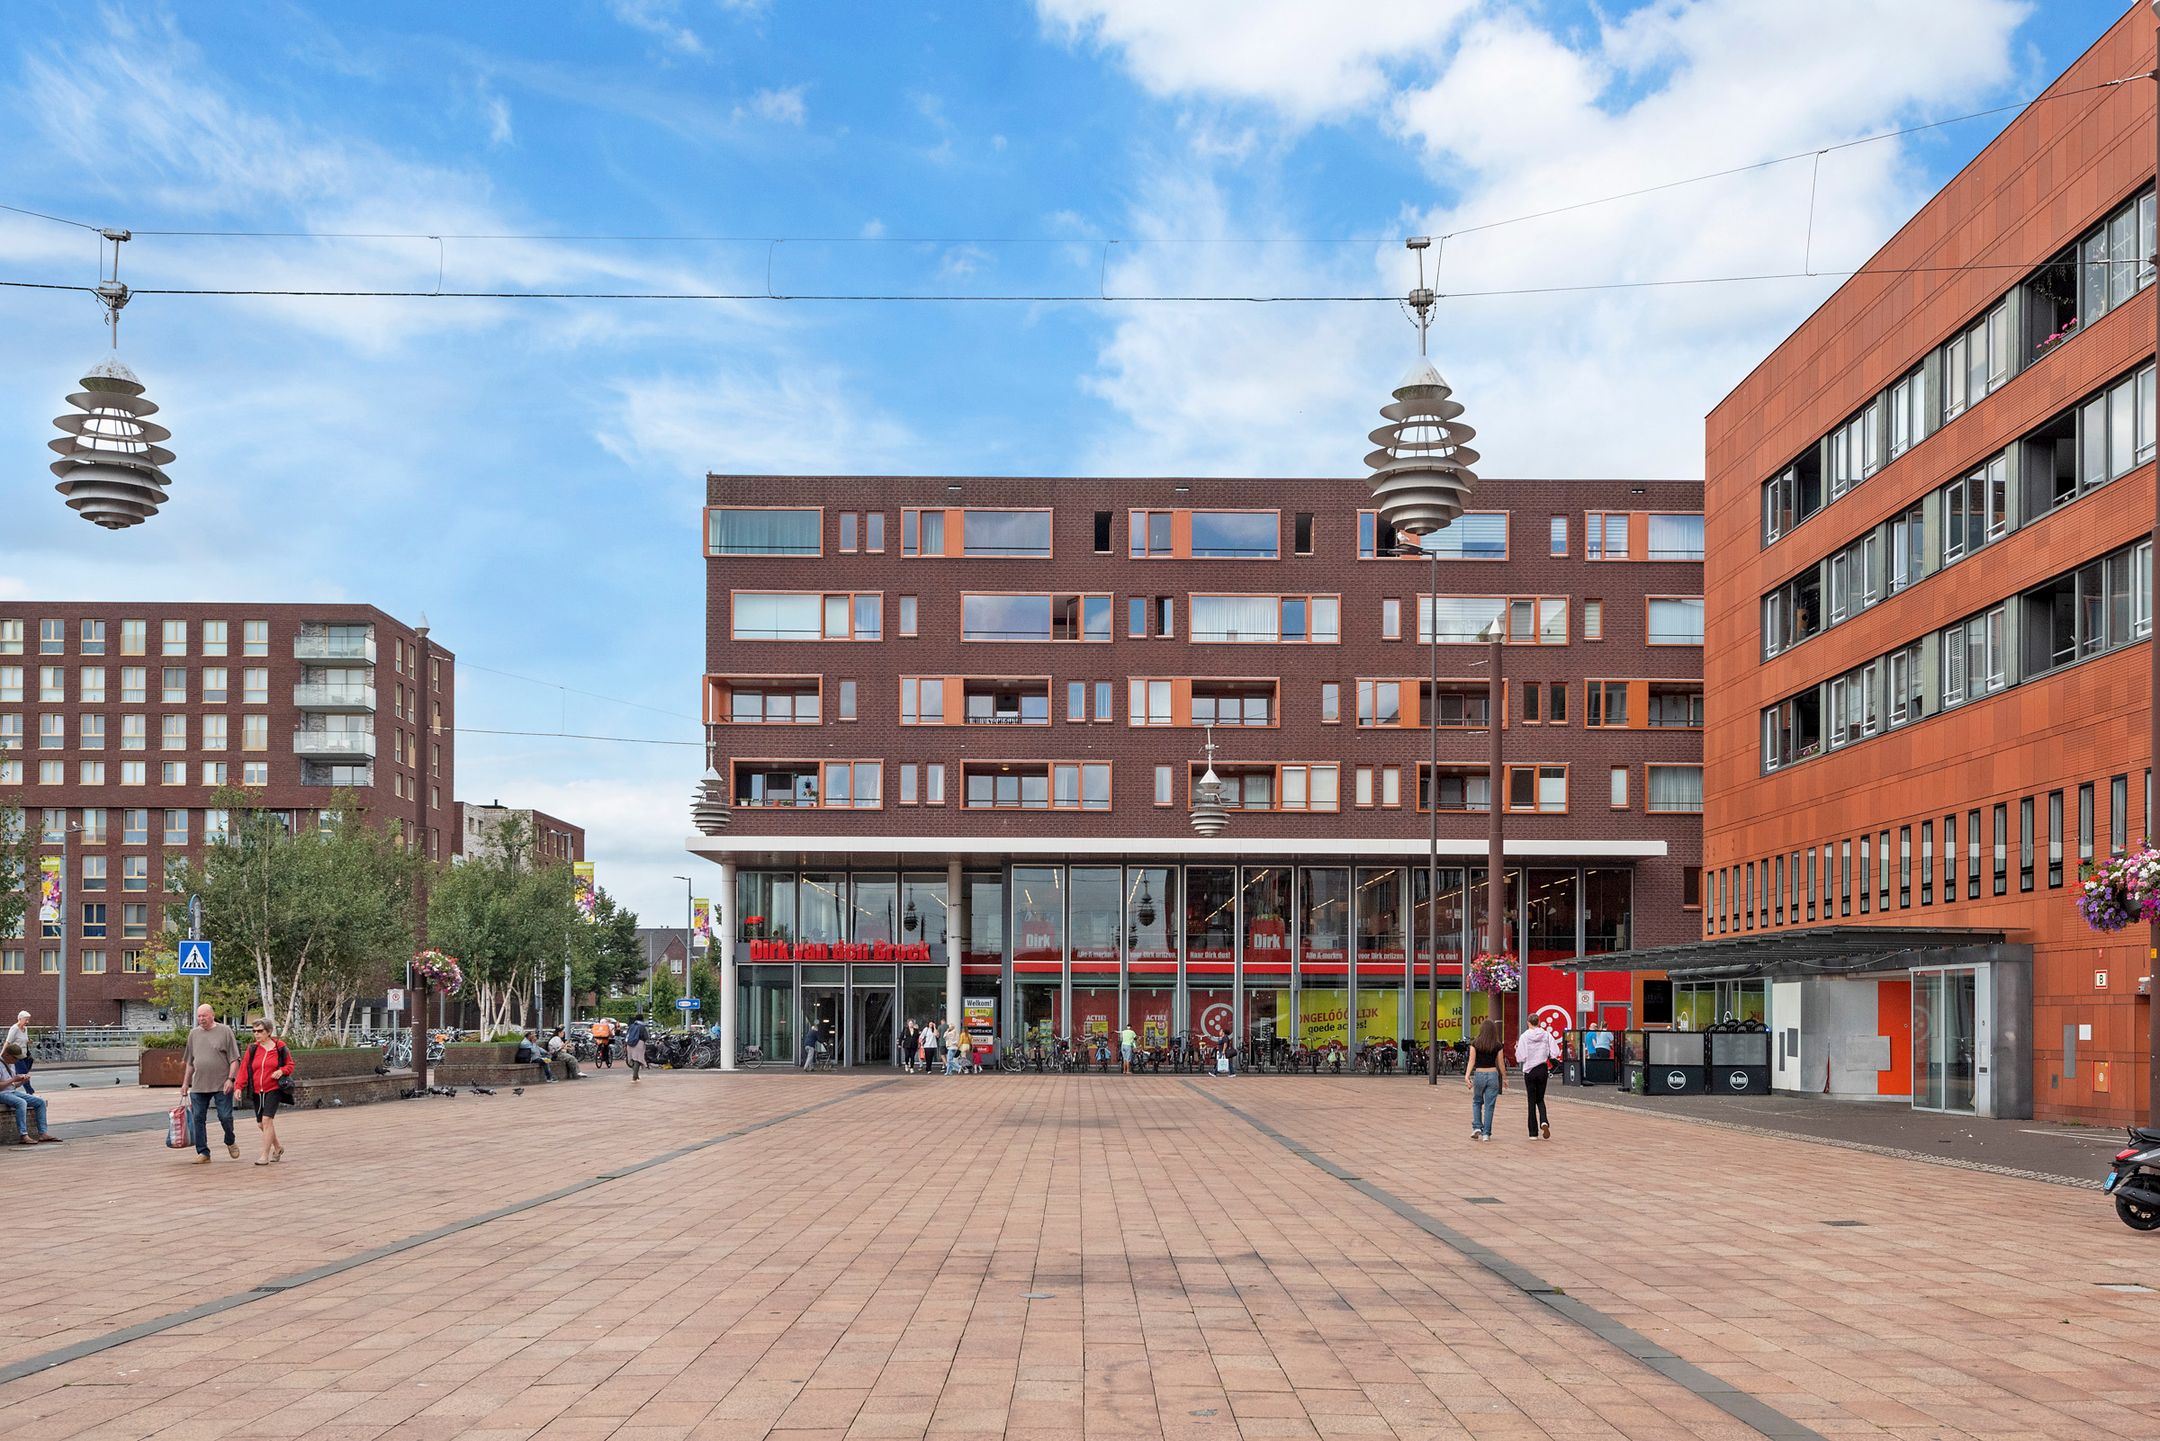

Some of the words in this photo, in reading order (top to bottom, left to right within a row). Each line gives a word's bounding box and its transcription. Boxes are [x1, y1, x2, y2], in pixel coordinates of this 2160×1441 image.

[1026, 933, 1050, 947] Dirk
[1254, 933, 1281, 949] Dirk
[749, 939, 789, 960] Dirk
[793, 944, 828, 960] van
[832, 939, 869, 960] den
[873, 938, 930, 961] Broek
[966, 999, 992, 1007] Welkom!
[1299, 1007, 1378, 1024] NGELÓÓÓLIJK
[1308, 1022, 1335, 1034] goede
[1337, 1019, 1367, 1031] acs!
